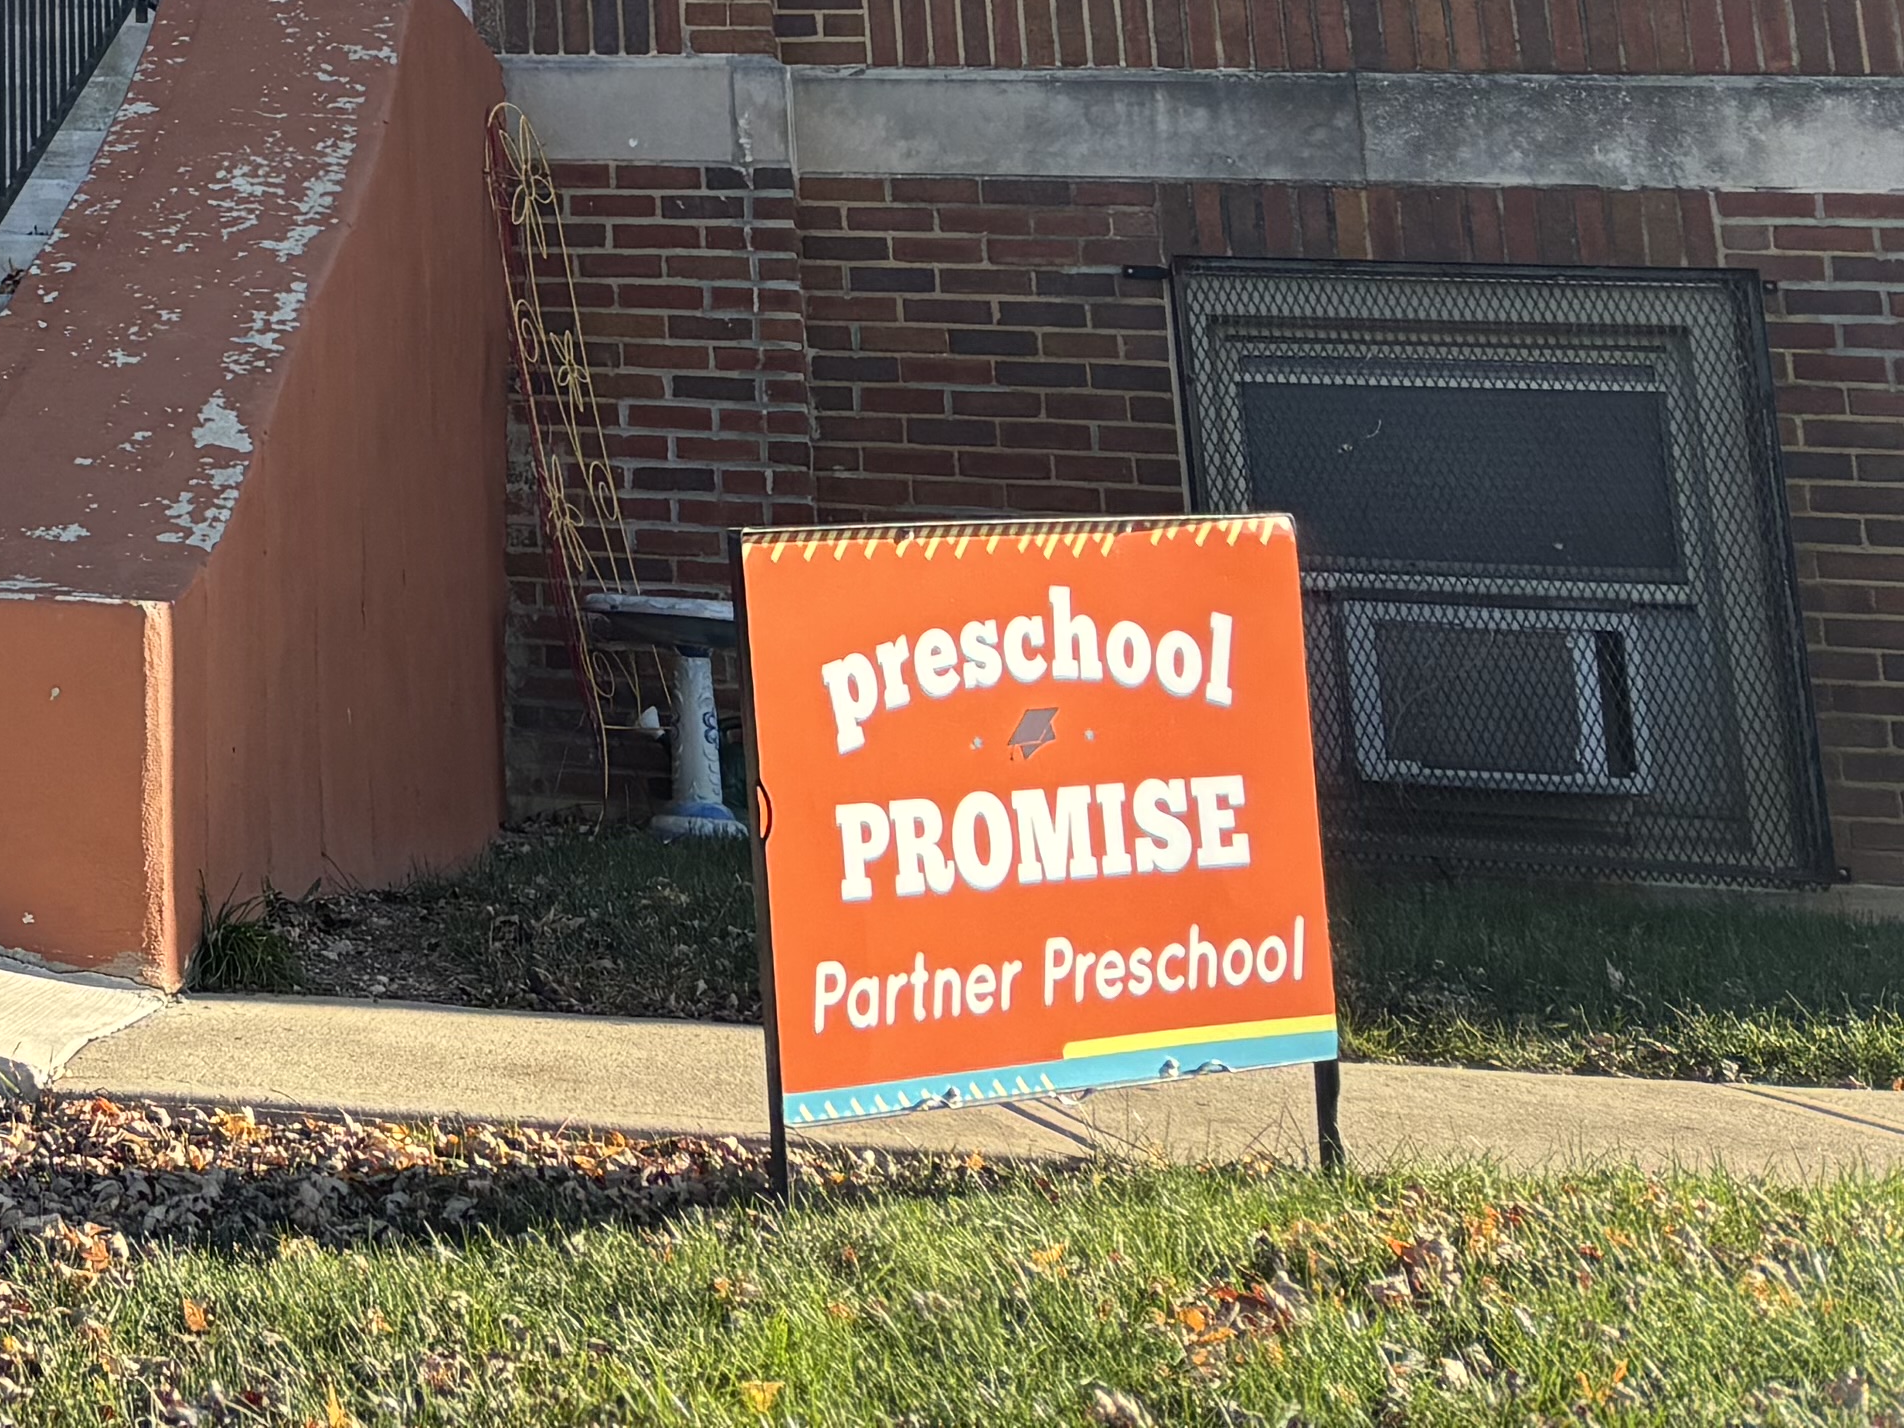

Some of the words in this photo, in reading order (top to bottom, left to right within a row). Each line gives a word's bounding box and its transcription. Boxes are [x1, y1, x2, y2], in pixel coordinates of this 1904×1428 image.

[822, 585, 1233, 755] preschool
[835, 774, 1250, 904] PROMISE
[814, 951, 1022, 1034] Partner
[1044, 915, 1305, 1007] Preschool
